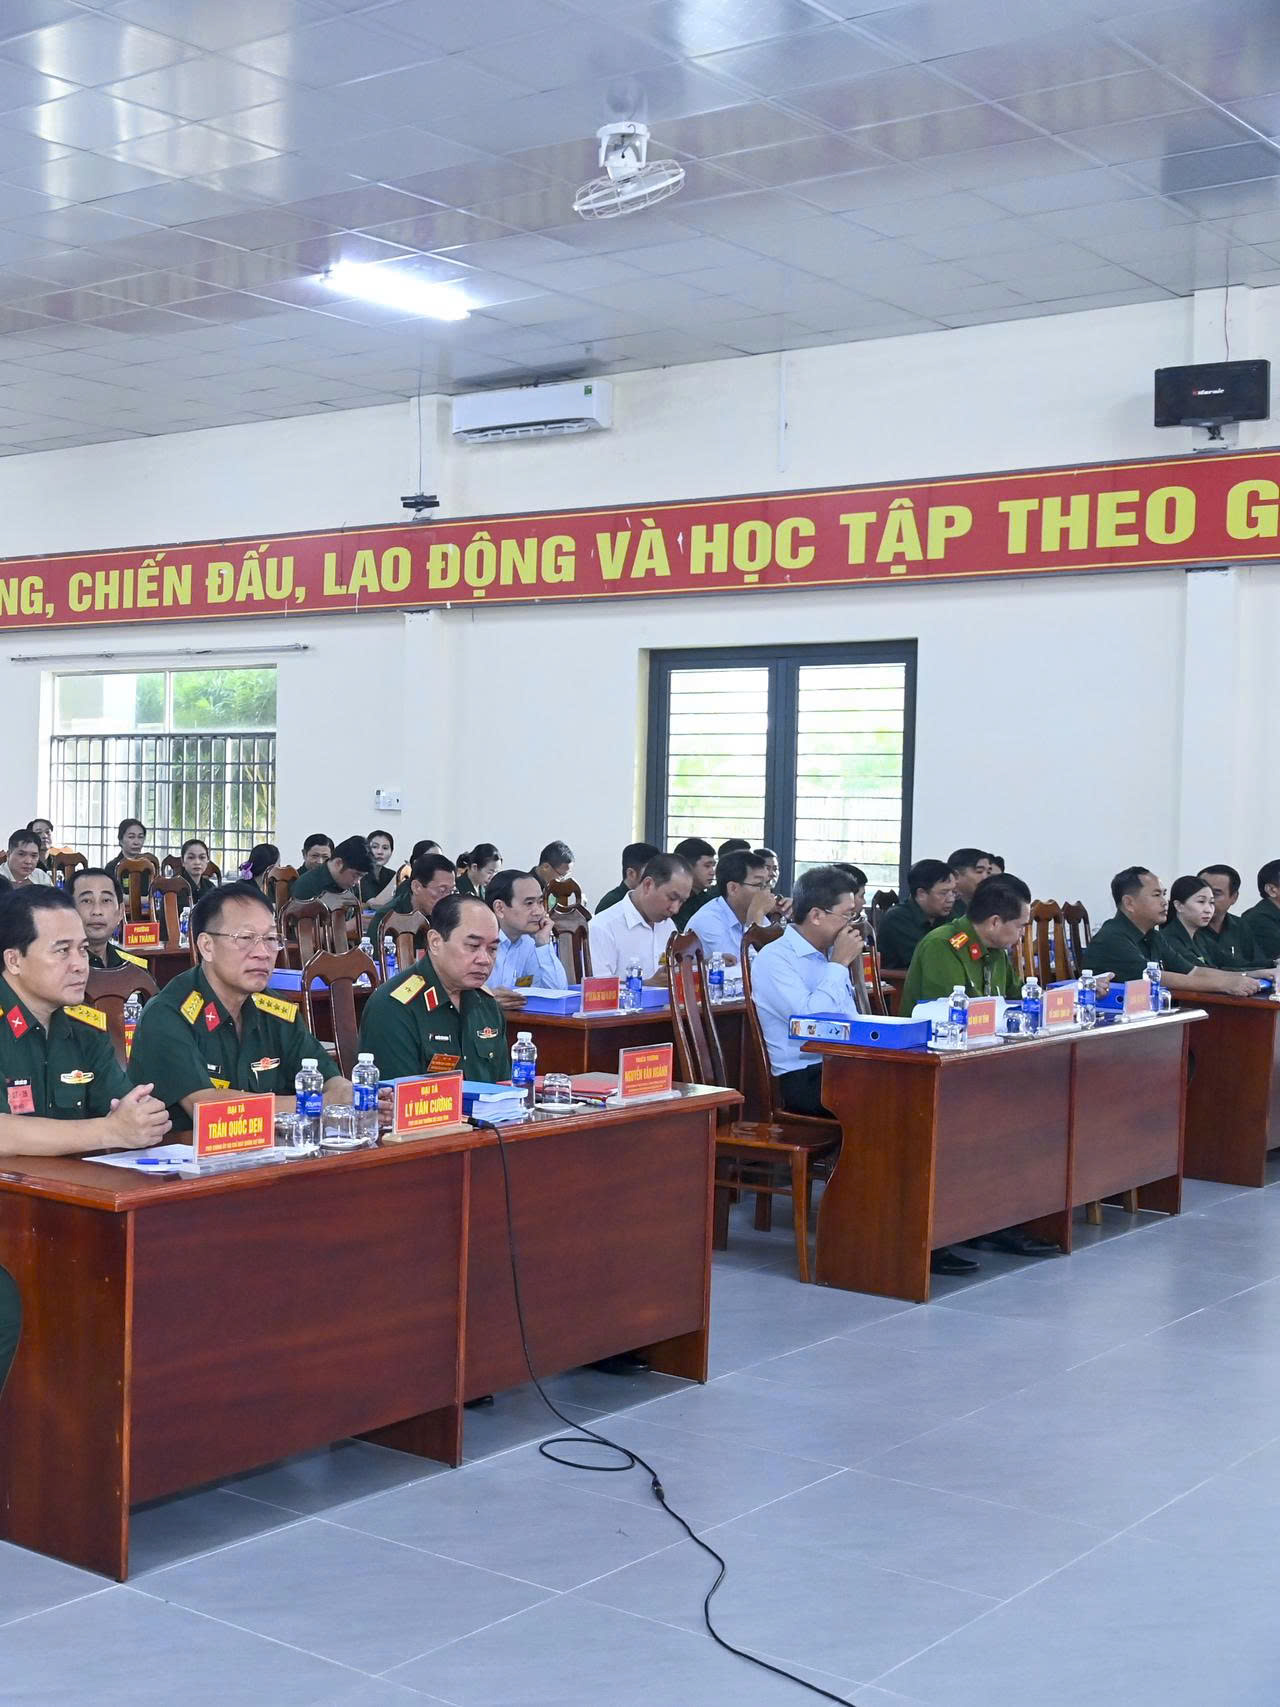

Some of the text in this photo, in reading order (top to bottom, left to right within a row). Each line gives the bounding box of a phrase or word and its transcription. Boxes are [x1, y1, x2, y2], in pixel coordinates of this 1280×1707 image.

[68, 552, 193, 612] CHIẾN
[205, 543, 306, 604] ĐẤU,
[324, 545, 412, 595] LAO
[426, 531, 576, 597] ĐỘNG
[596, 518, 671, 580] VÀ
[689, 516, 815, 583] HỌC
[840, 497, 973, 574] TẬP
[998, 485, 1197, 554] THEO
[415, 1099, 429, 1116] VĂN
[228, 1114, 248, 1137] QUỐC
